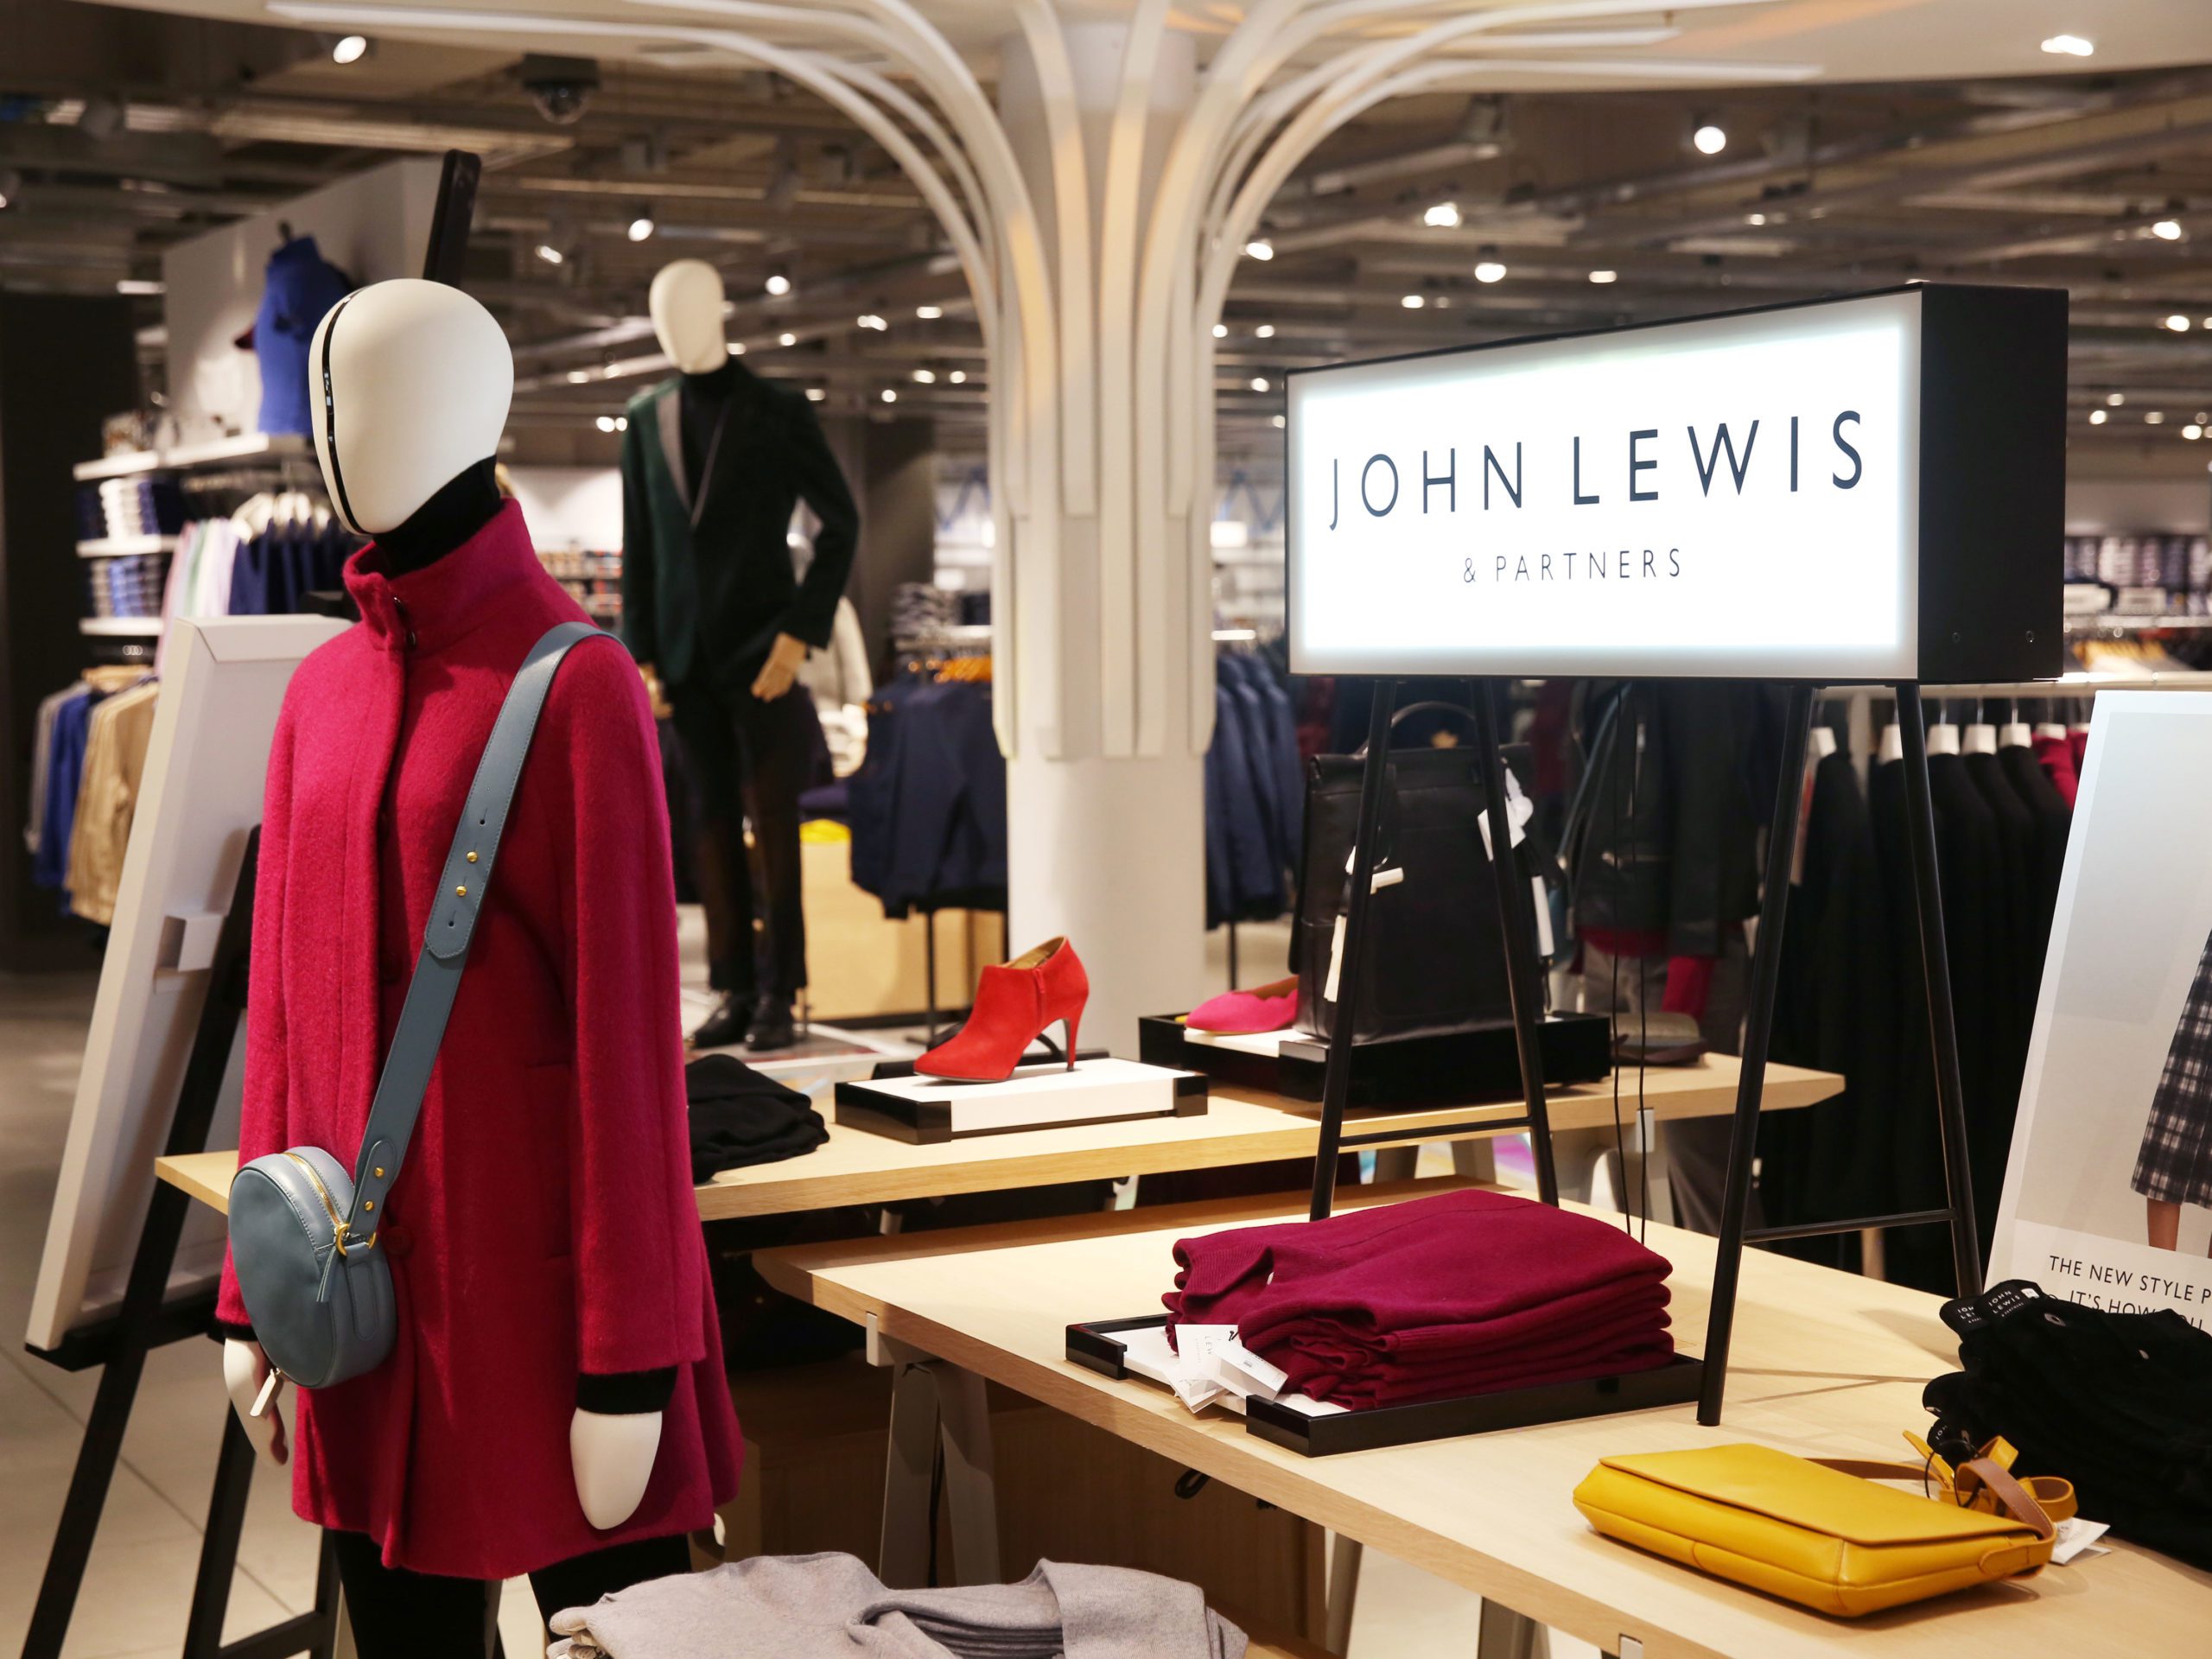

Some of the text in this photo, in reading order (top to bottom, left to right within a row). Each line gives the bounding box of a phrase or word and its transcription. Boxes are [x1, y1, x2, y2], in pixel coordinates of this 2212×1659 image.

[1329, 410, 1863, 531] JOHN LEWIS
[1463, 548, 1681, 583] & PARTNERS
[2050, 1255, 2082, 1276] THE
[2089, 1264, 2133, 1287] NEW
[2139, 1274, 2194, 1301] STYLE
[1993, 1294, 2021, 1314] LEWIS
